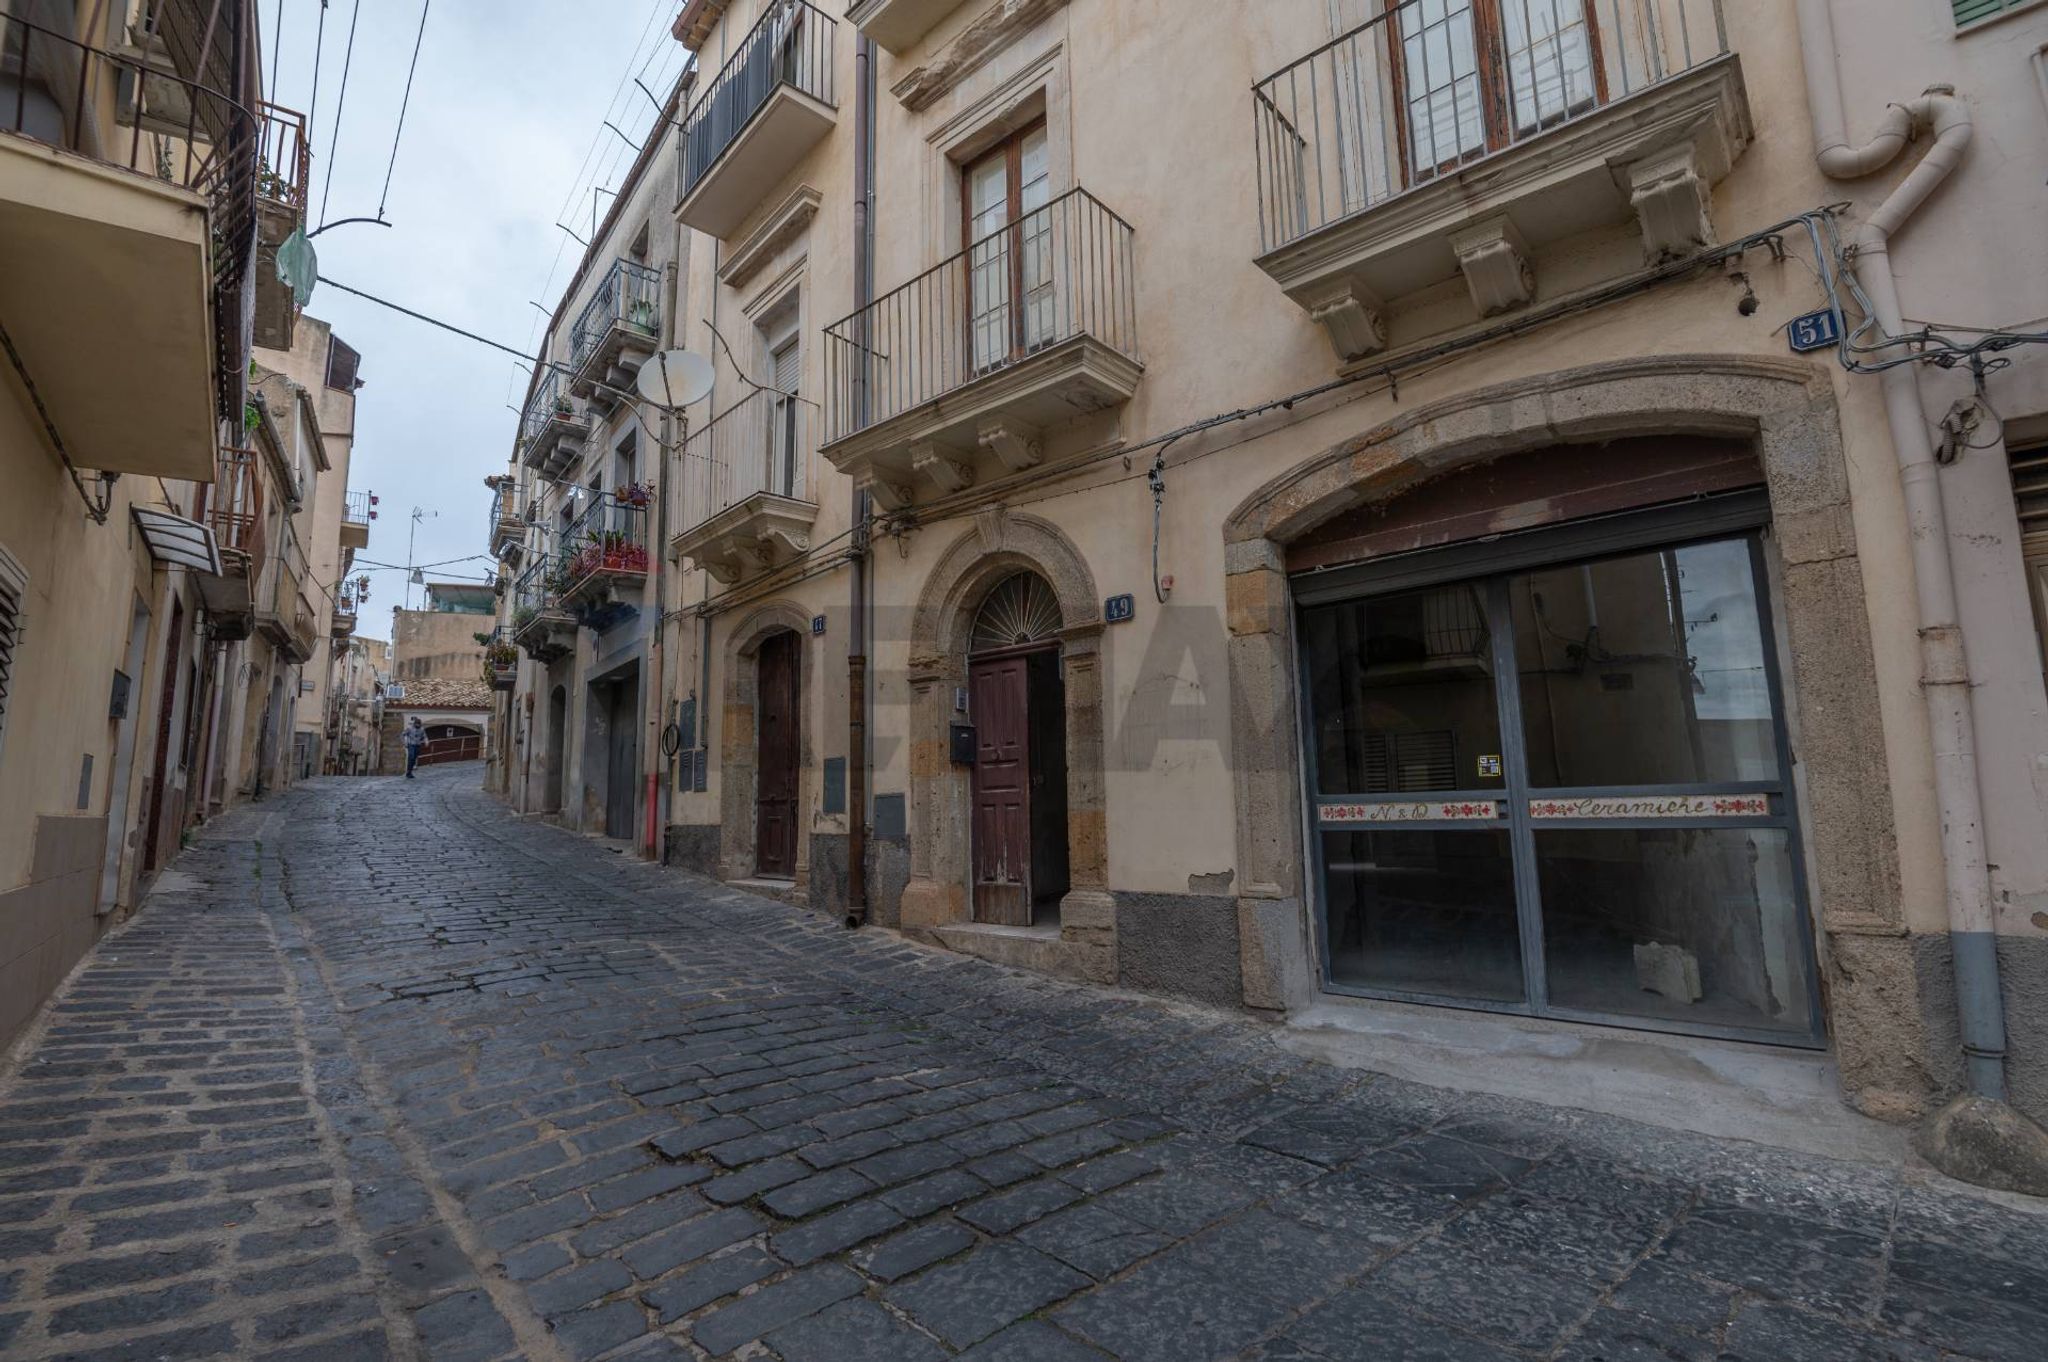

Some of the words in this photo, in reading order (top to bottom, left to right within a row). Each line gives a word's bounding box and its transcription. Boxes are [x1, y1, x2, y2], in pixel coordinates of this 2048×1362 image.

[1799, 313, 1834, 344] 51
[1110, 598, 1128, 617] 49
[1573, 797, 1709, 816] Ceramiche
